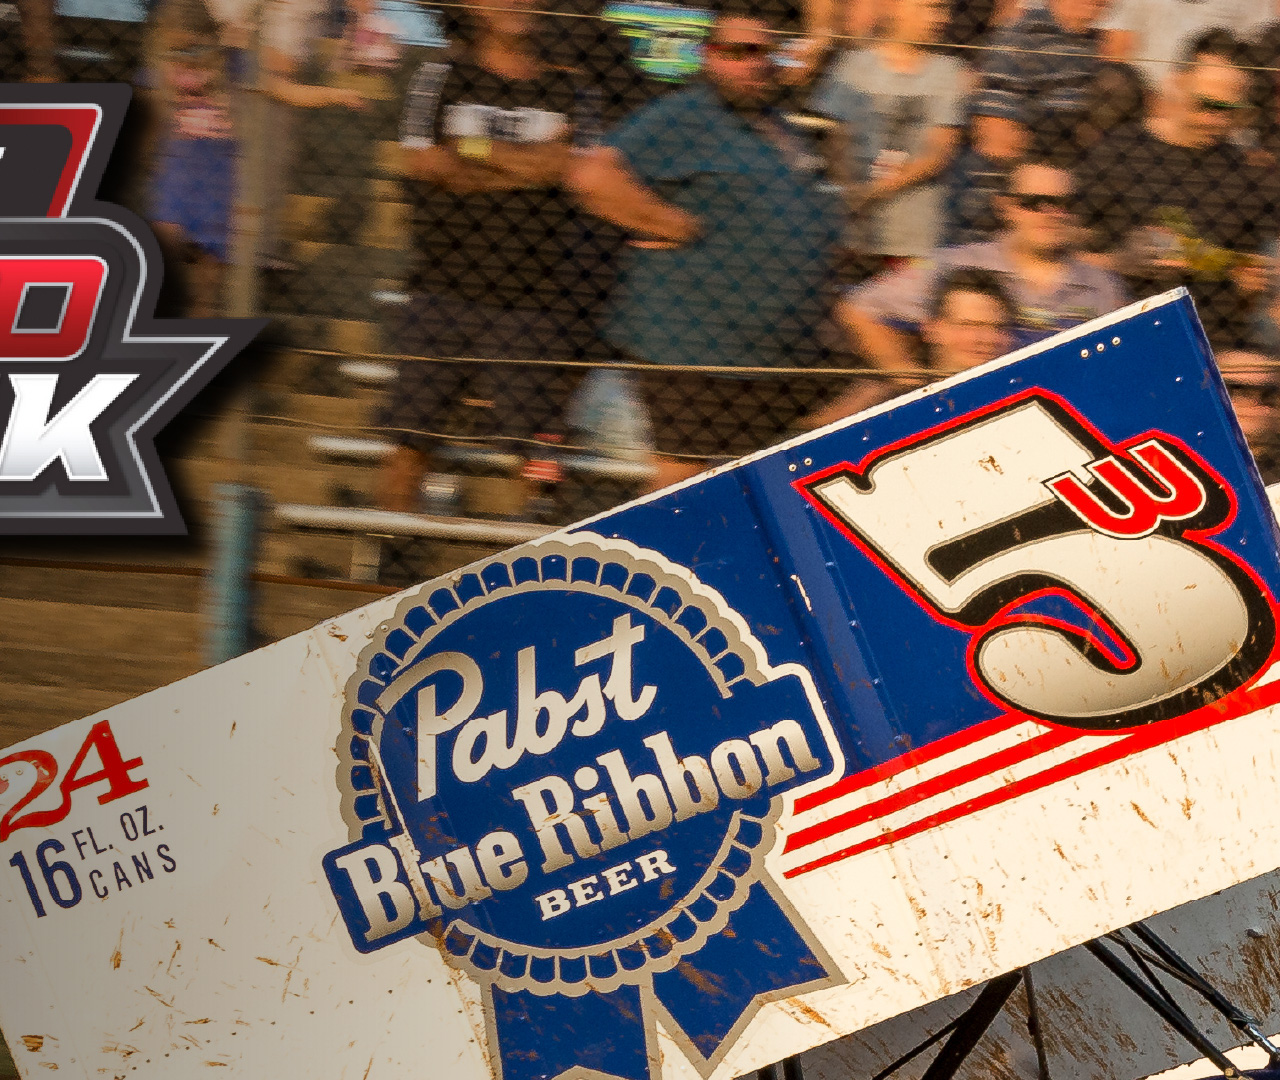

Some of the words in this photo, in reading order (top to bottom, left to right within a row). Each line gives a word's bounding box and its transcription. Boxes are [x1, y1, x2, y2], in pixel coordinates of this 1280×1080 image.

[376, 612, 657, 802] Pabst
[72, 827, 114, 860] FL.
[120, 805, 165, 842] OZ.
[334, 828, 529, 943] Blue
[512, 719, 822, 875] Ribbon
[9, 838, 82, 918] 16
[89, 844, 177, 899] CANS
[535, 849, 677, 922] BEER
